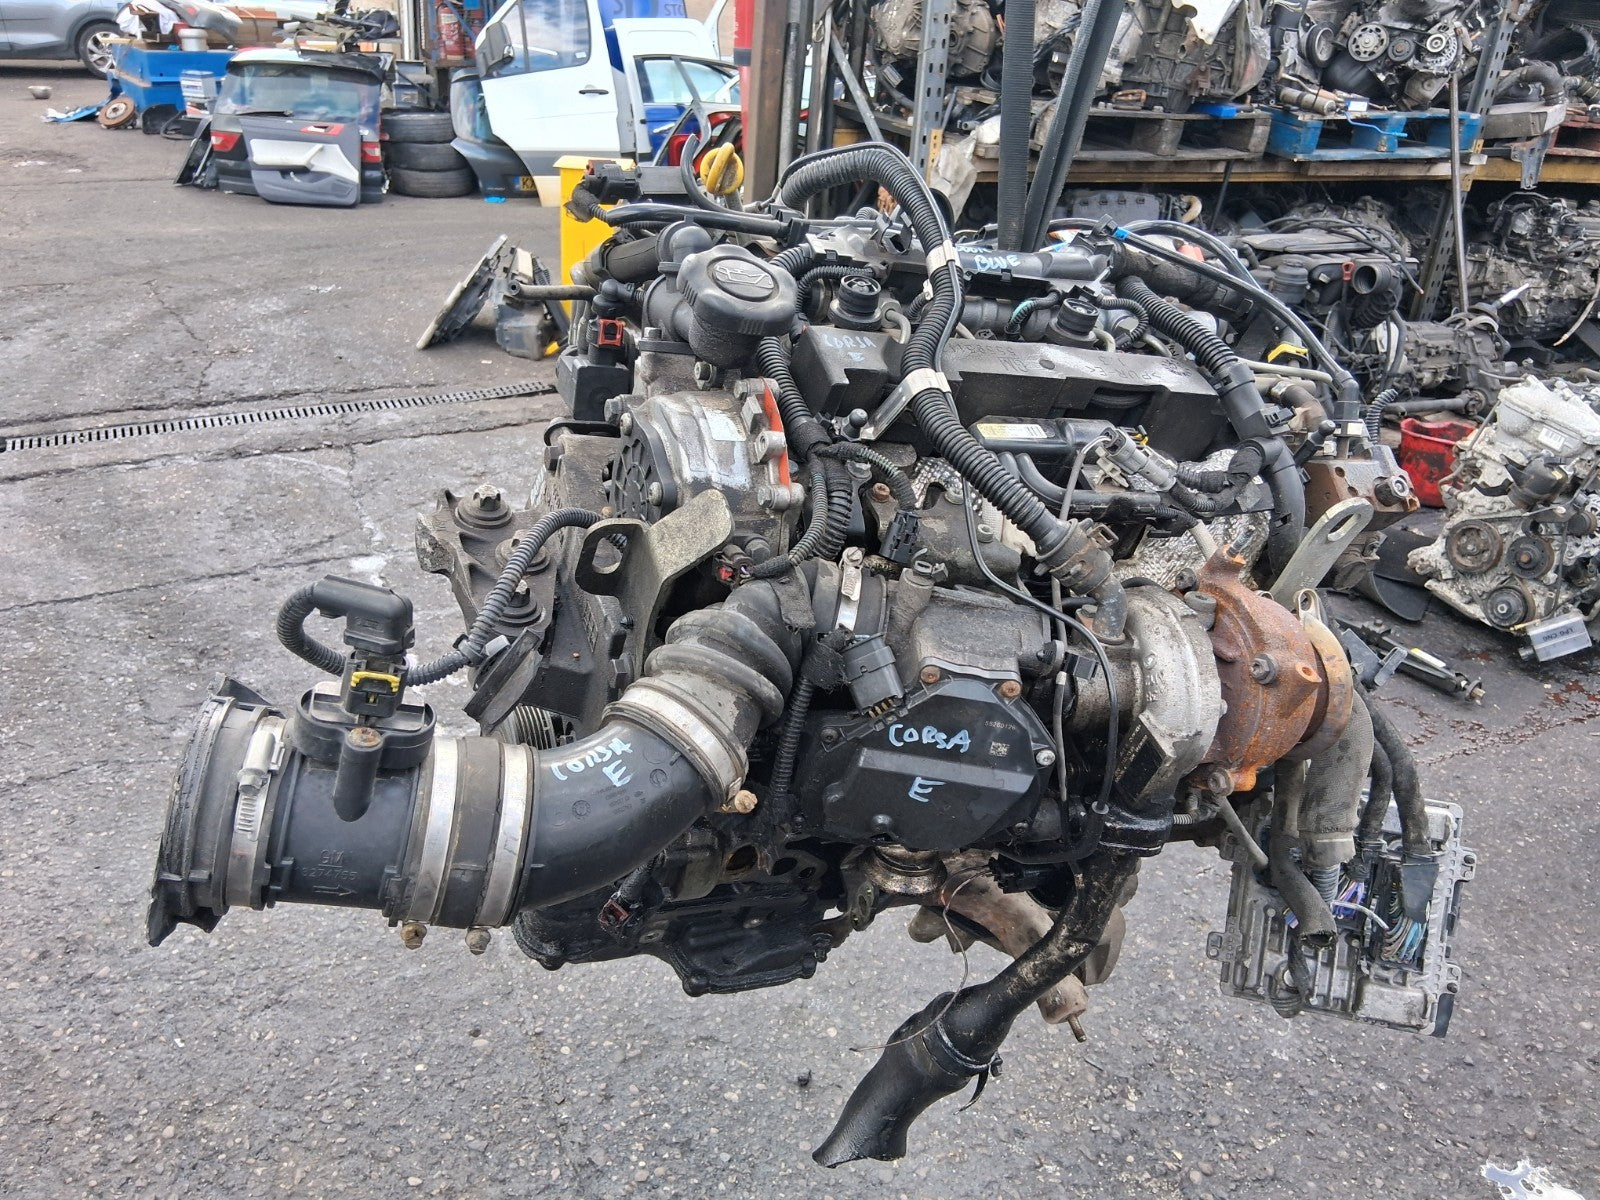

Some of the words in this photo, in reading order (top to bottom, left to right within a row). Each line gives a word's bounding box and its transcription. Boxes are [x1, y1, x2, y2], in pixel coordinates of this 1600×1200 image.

[974, 254, 1020, 271] BLUE
[888, 723, 971, 753] CORSA
[602, 759, 634, 787] E
[908, 776, 946, 802] E
